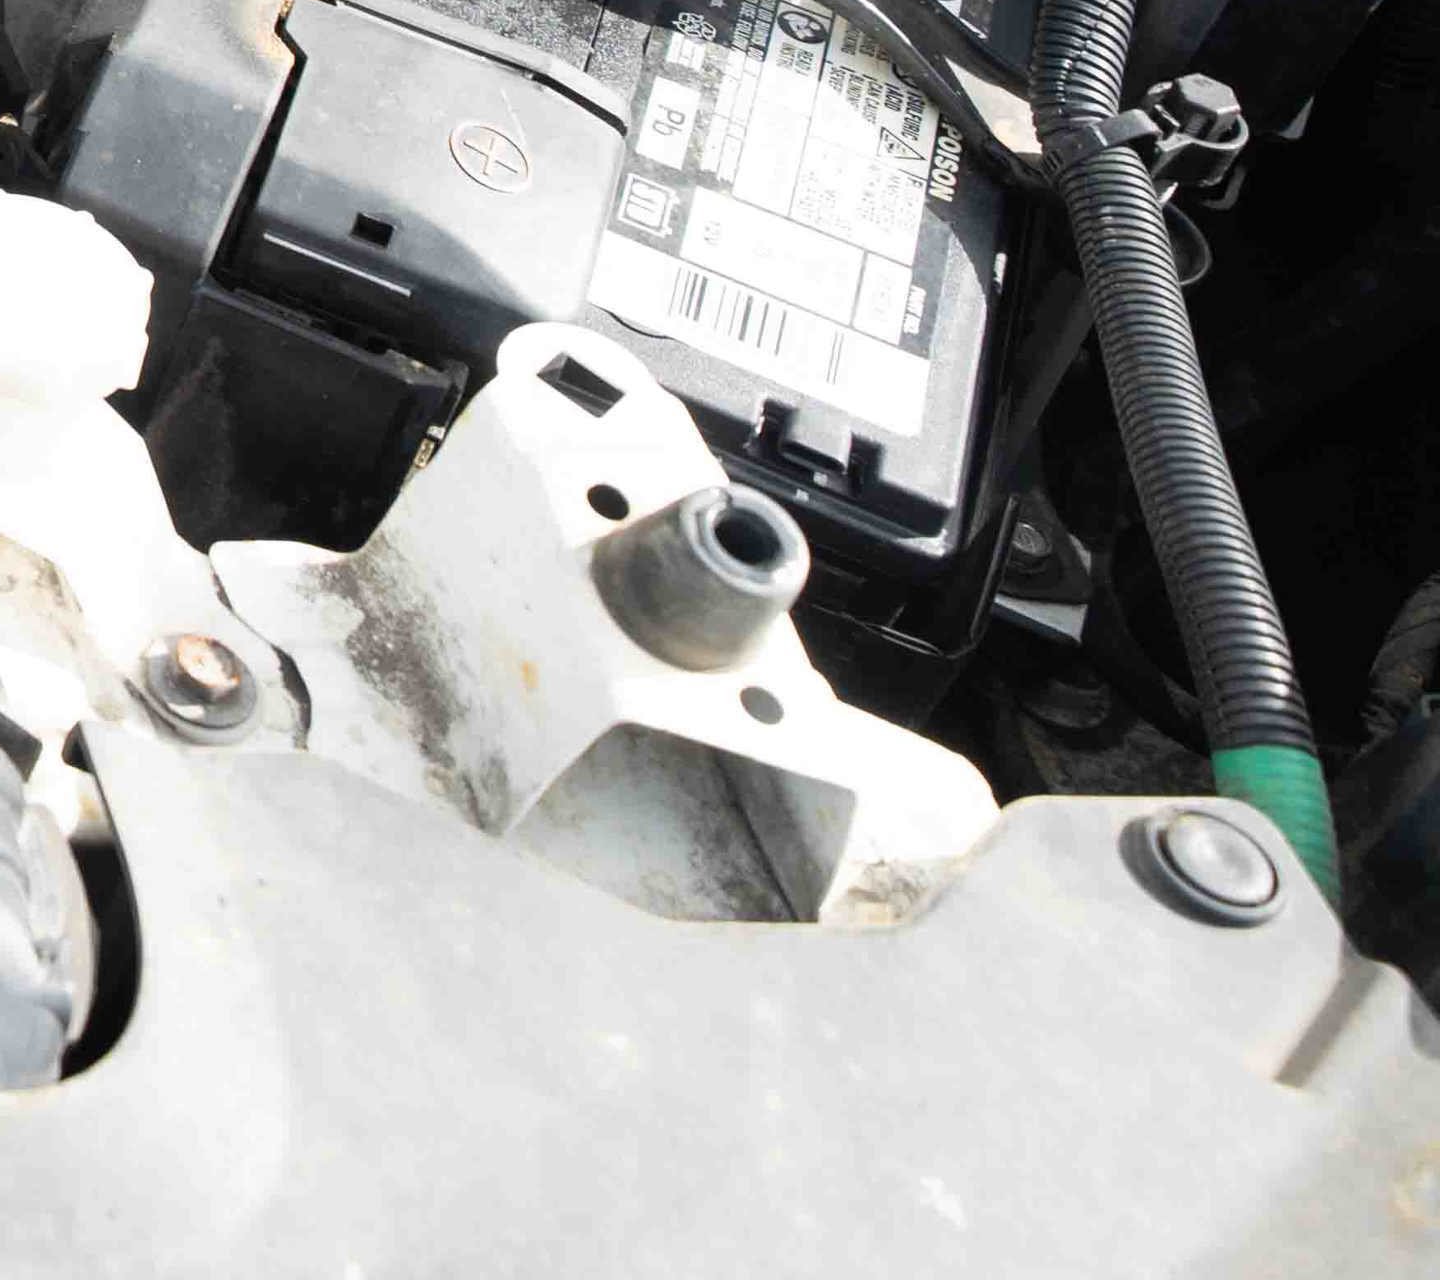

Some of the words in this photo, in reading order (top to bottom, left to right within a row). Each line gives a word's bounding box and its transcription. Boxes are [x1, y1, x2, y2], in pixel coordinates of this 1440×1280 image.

[866, 81, 882, 99] CAN
[885, 88, 903, 113] ACID
[652, 104, 686, 138] Pb
[902, 95, 925, 141] SULFURIC
[930, 123, 963, 202] POISON
